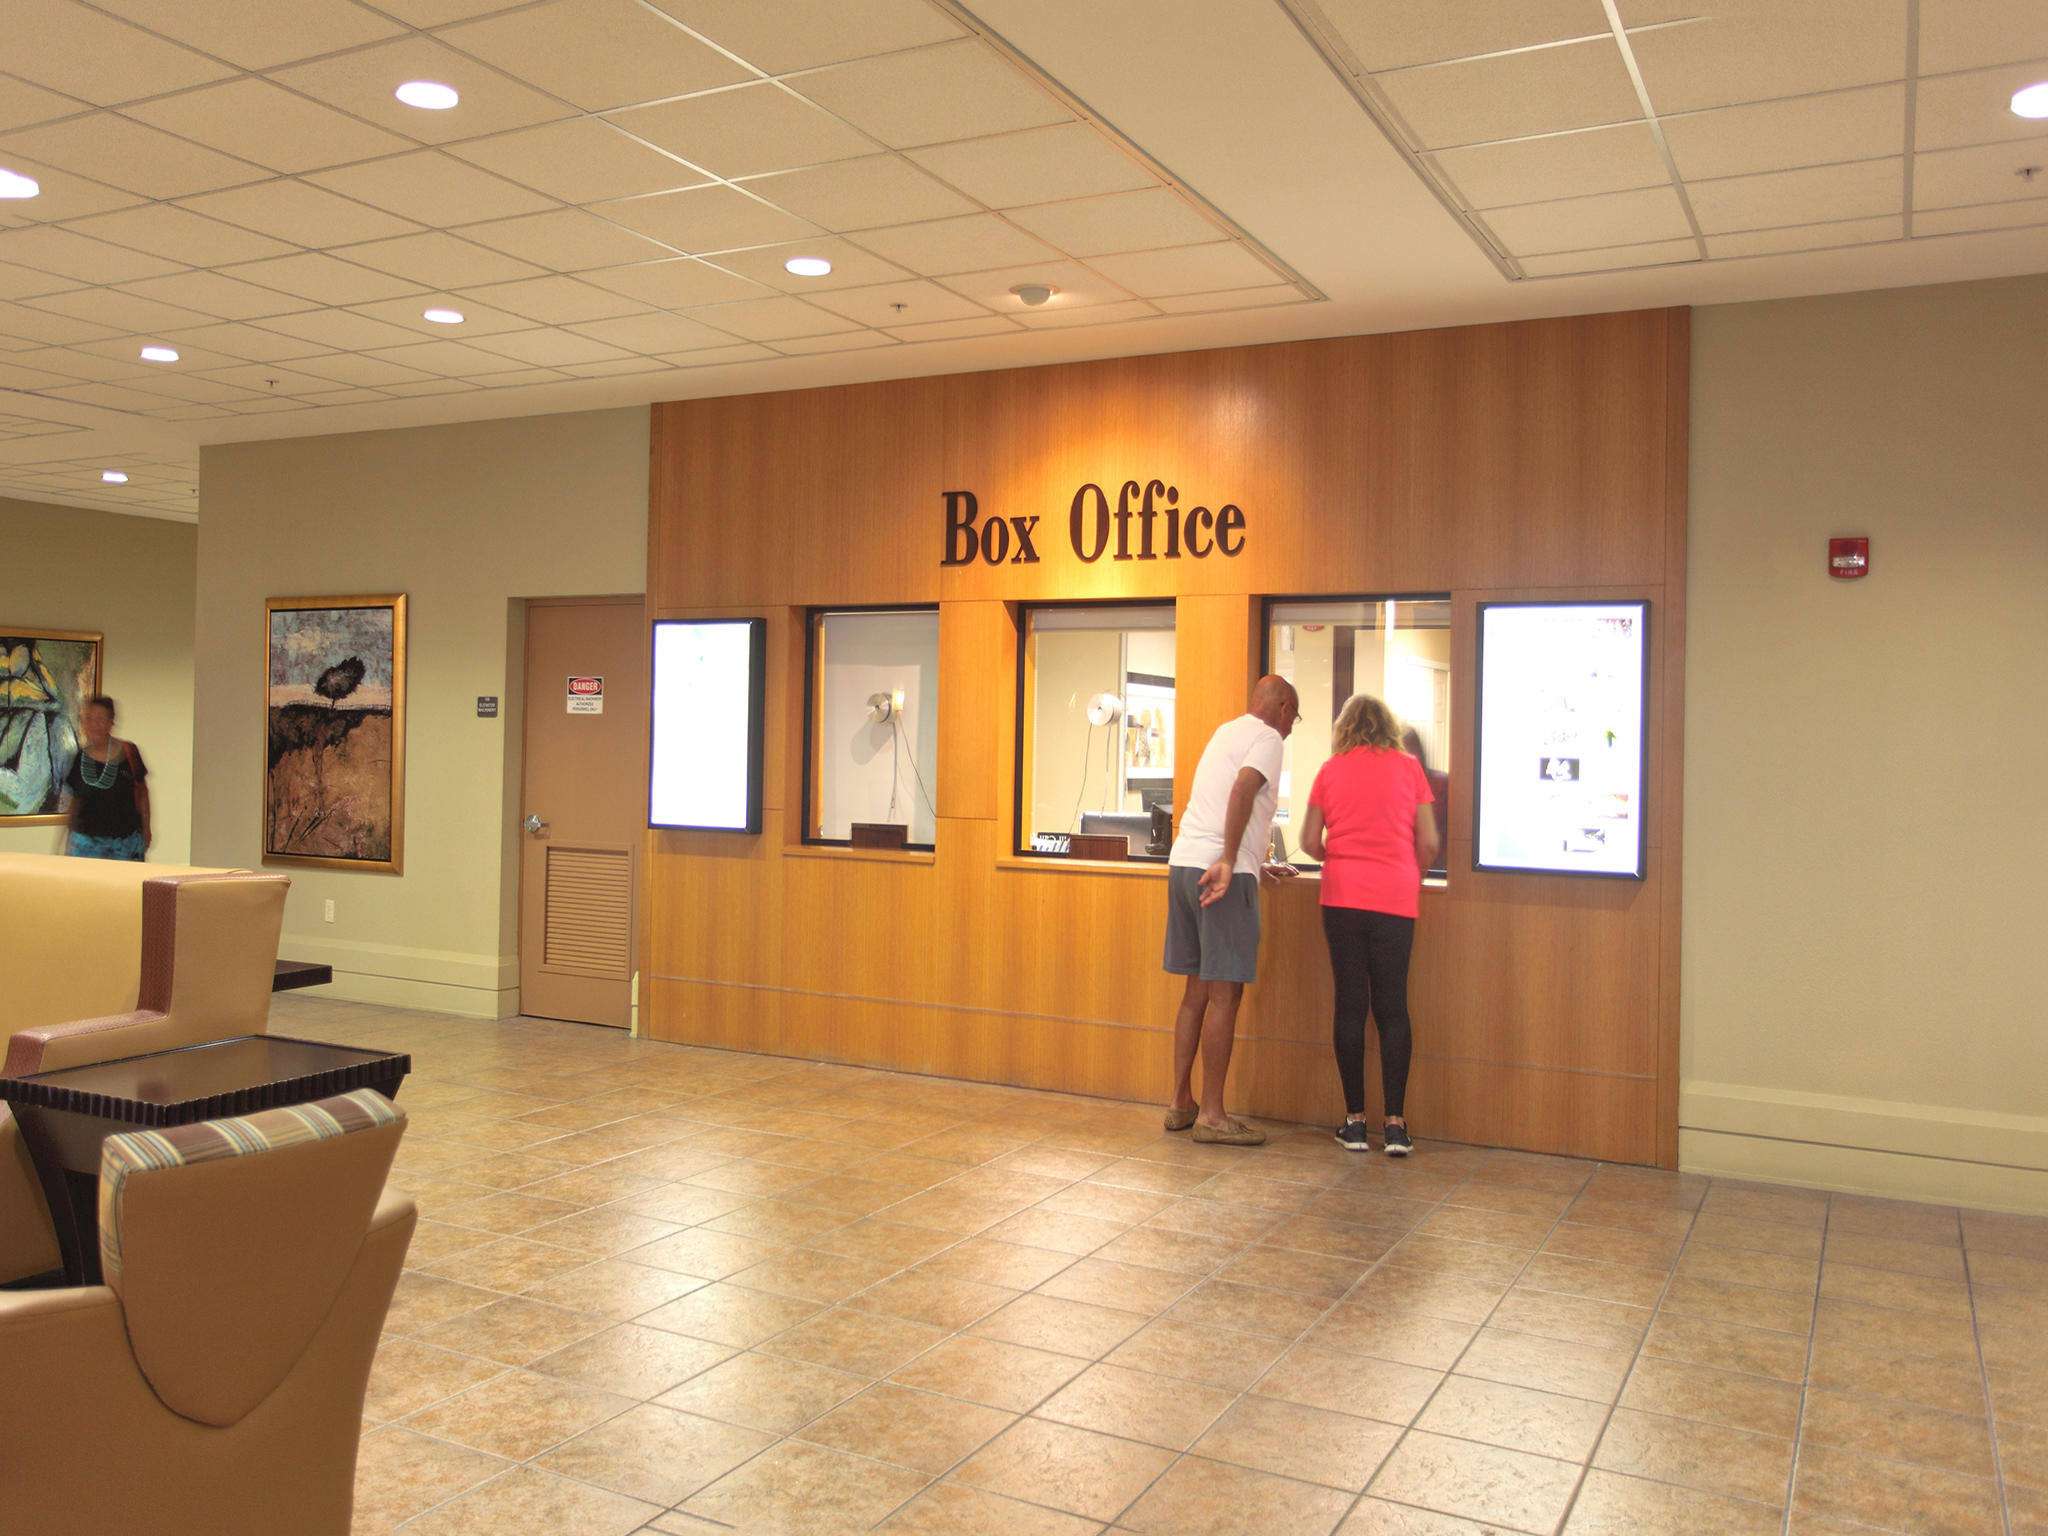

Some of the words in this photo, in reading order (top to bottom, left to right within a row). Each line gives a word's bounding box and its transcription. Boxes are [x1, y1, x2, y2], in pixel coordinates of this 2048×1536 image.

[941, 491, 1040, 567] Box
[1069, 479, 1246, 563] Office
[573, 682, 598, 691] DANGER
